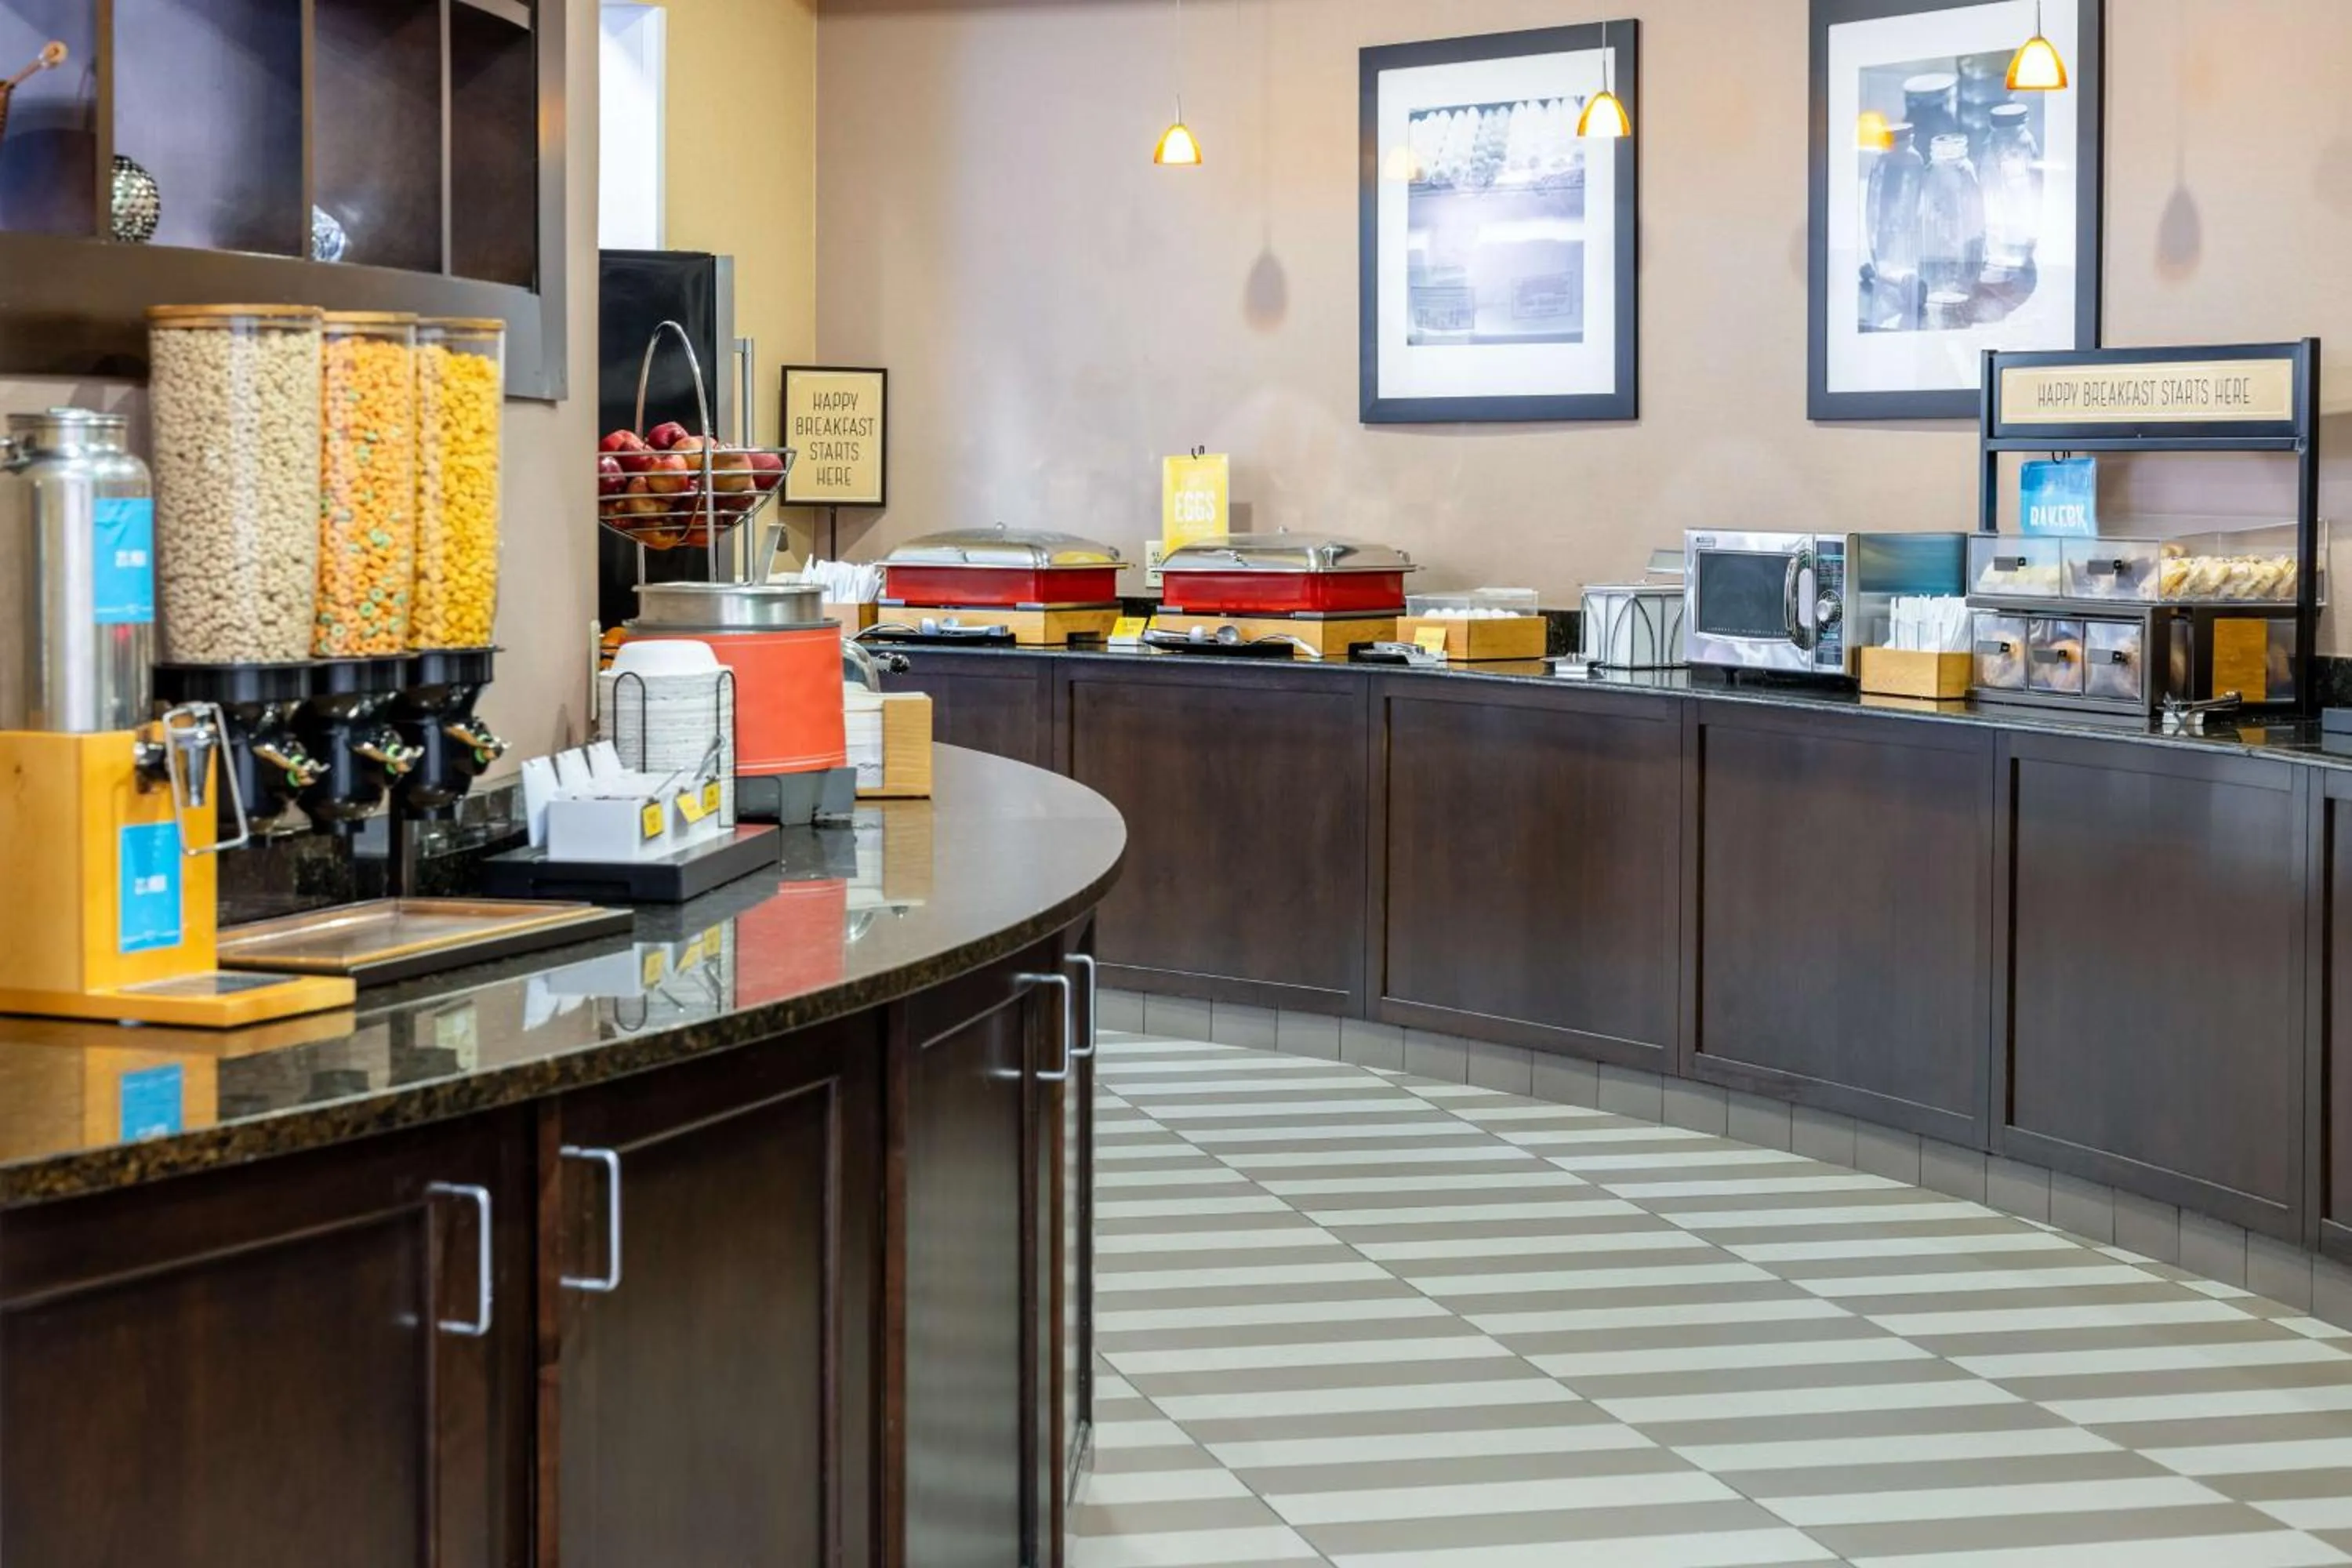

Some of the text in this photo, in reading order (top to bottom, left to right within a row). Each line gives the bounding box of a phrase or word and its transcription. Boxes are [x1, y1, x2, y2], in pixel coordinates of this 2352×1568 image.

[813, 393, 858, 411] HAPPY
[2037, 377, 2252, 408] HAPPY BREAKFAST STARTS HERE
[795, 417, 875, 436] BREAKFAST
[809, 442, 859, 461] STARTS
[816, 466, 851, 486] HERE
[1174, 491, 1216, 523] EGGS
